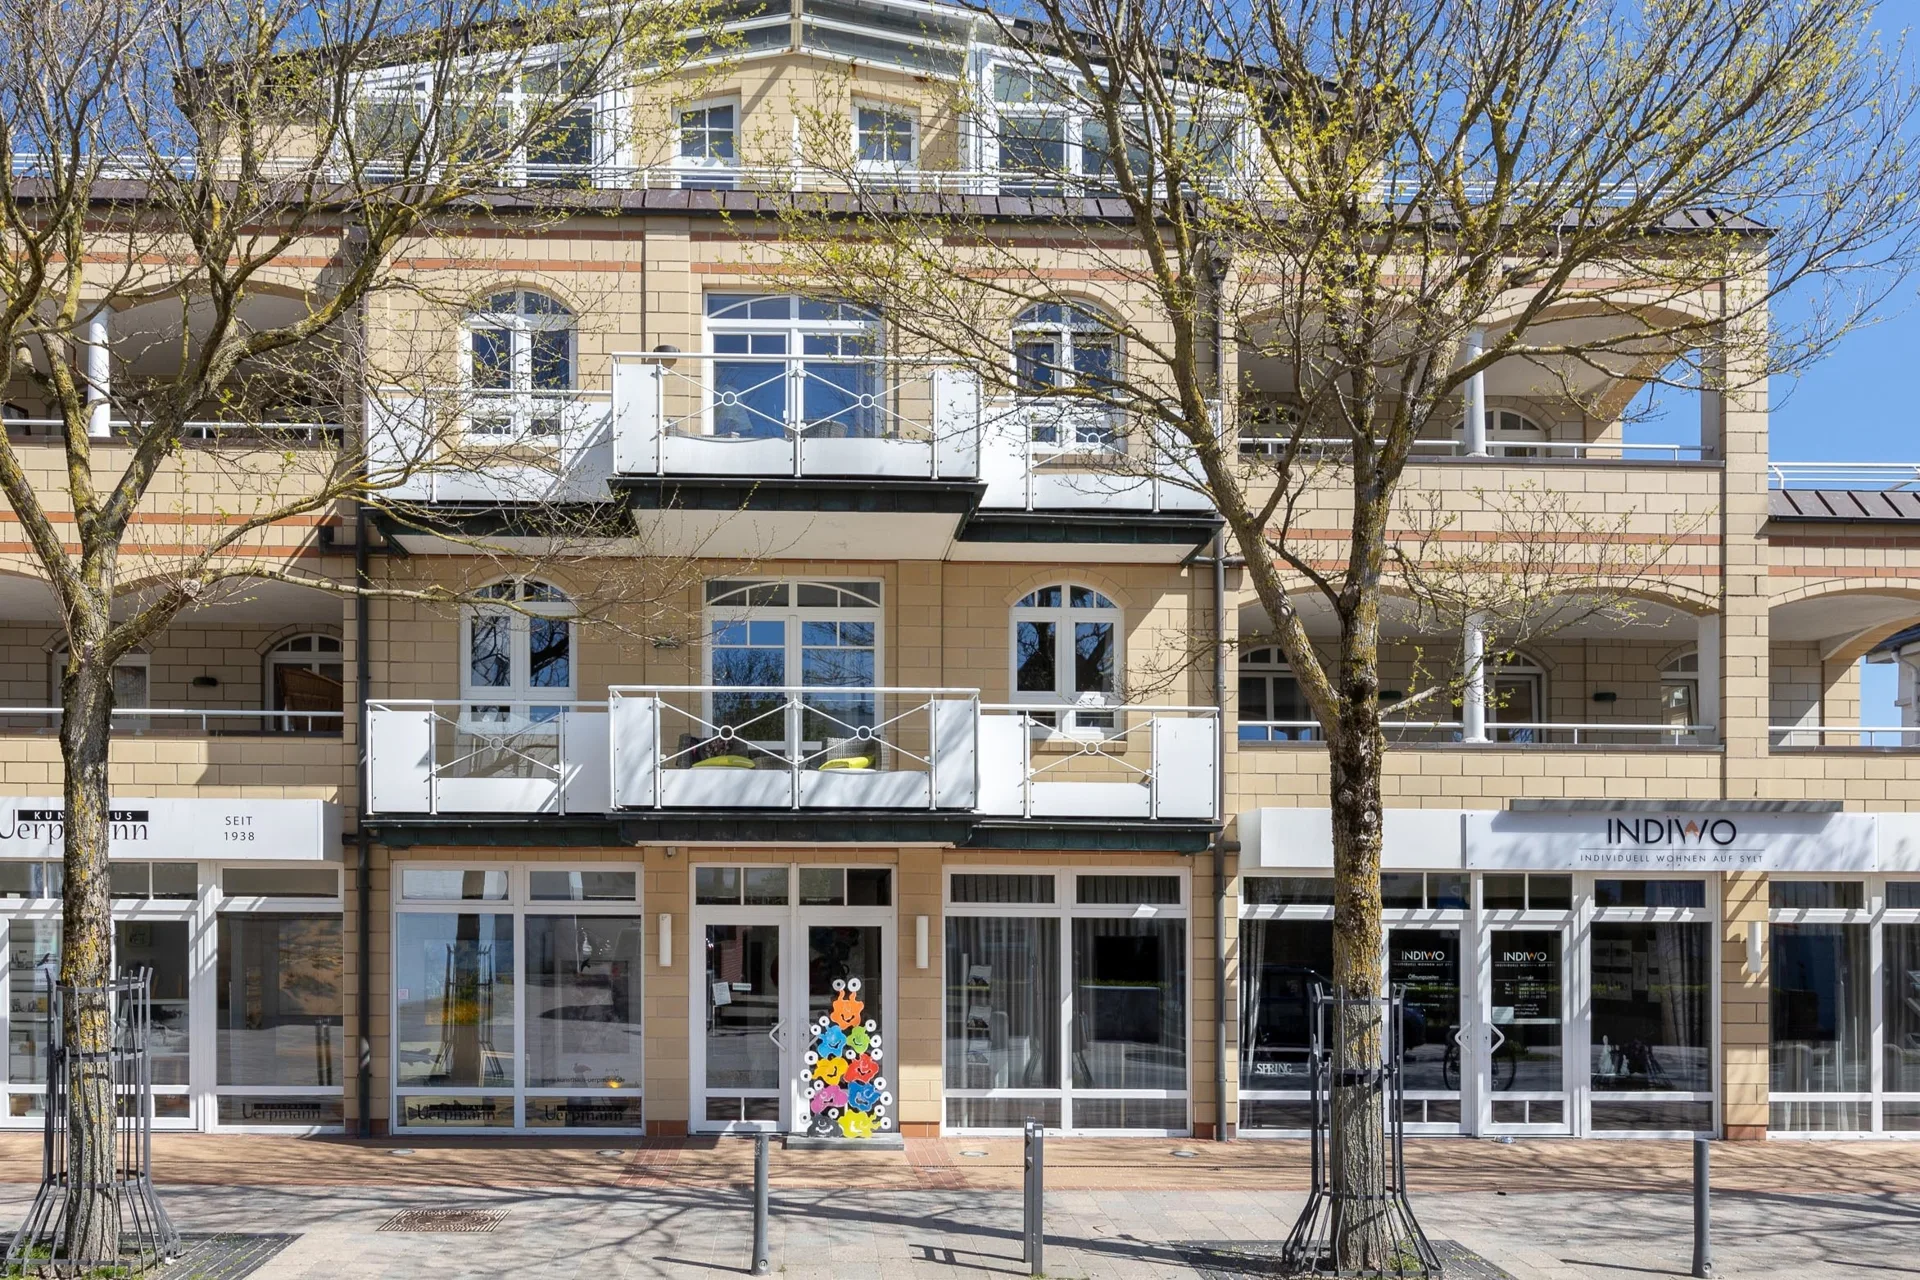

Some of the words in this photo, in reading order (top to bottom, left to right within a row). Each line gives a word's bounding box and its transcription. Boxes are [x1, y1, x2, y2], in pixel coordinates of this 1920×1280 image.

[34, 811, 133, 821] KUNUS
[225, 815, 253, 826] SEIT
[224, 831, 255, 841] 1938
[1607, 818, 1737, 846] INDIWO
[1580, 854, 1650, 863] INDIVIDUELL
[1656, 854, 1707, 863] WOHNEN
[1713, 854, 1734, 863] AUF
[1739, 854, 1763, 863] SYLT
[1401, 950, 1445, 961] INDIWO
[1503, 951, 1547, 962] INDIWO
[1256, 1063, 1293, 1075] SPRING
[242, 1103, 321, 1122] Uerpmann
[544, 1104, 623, 1122] Uerpmann
